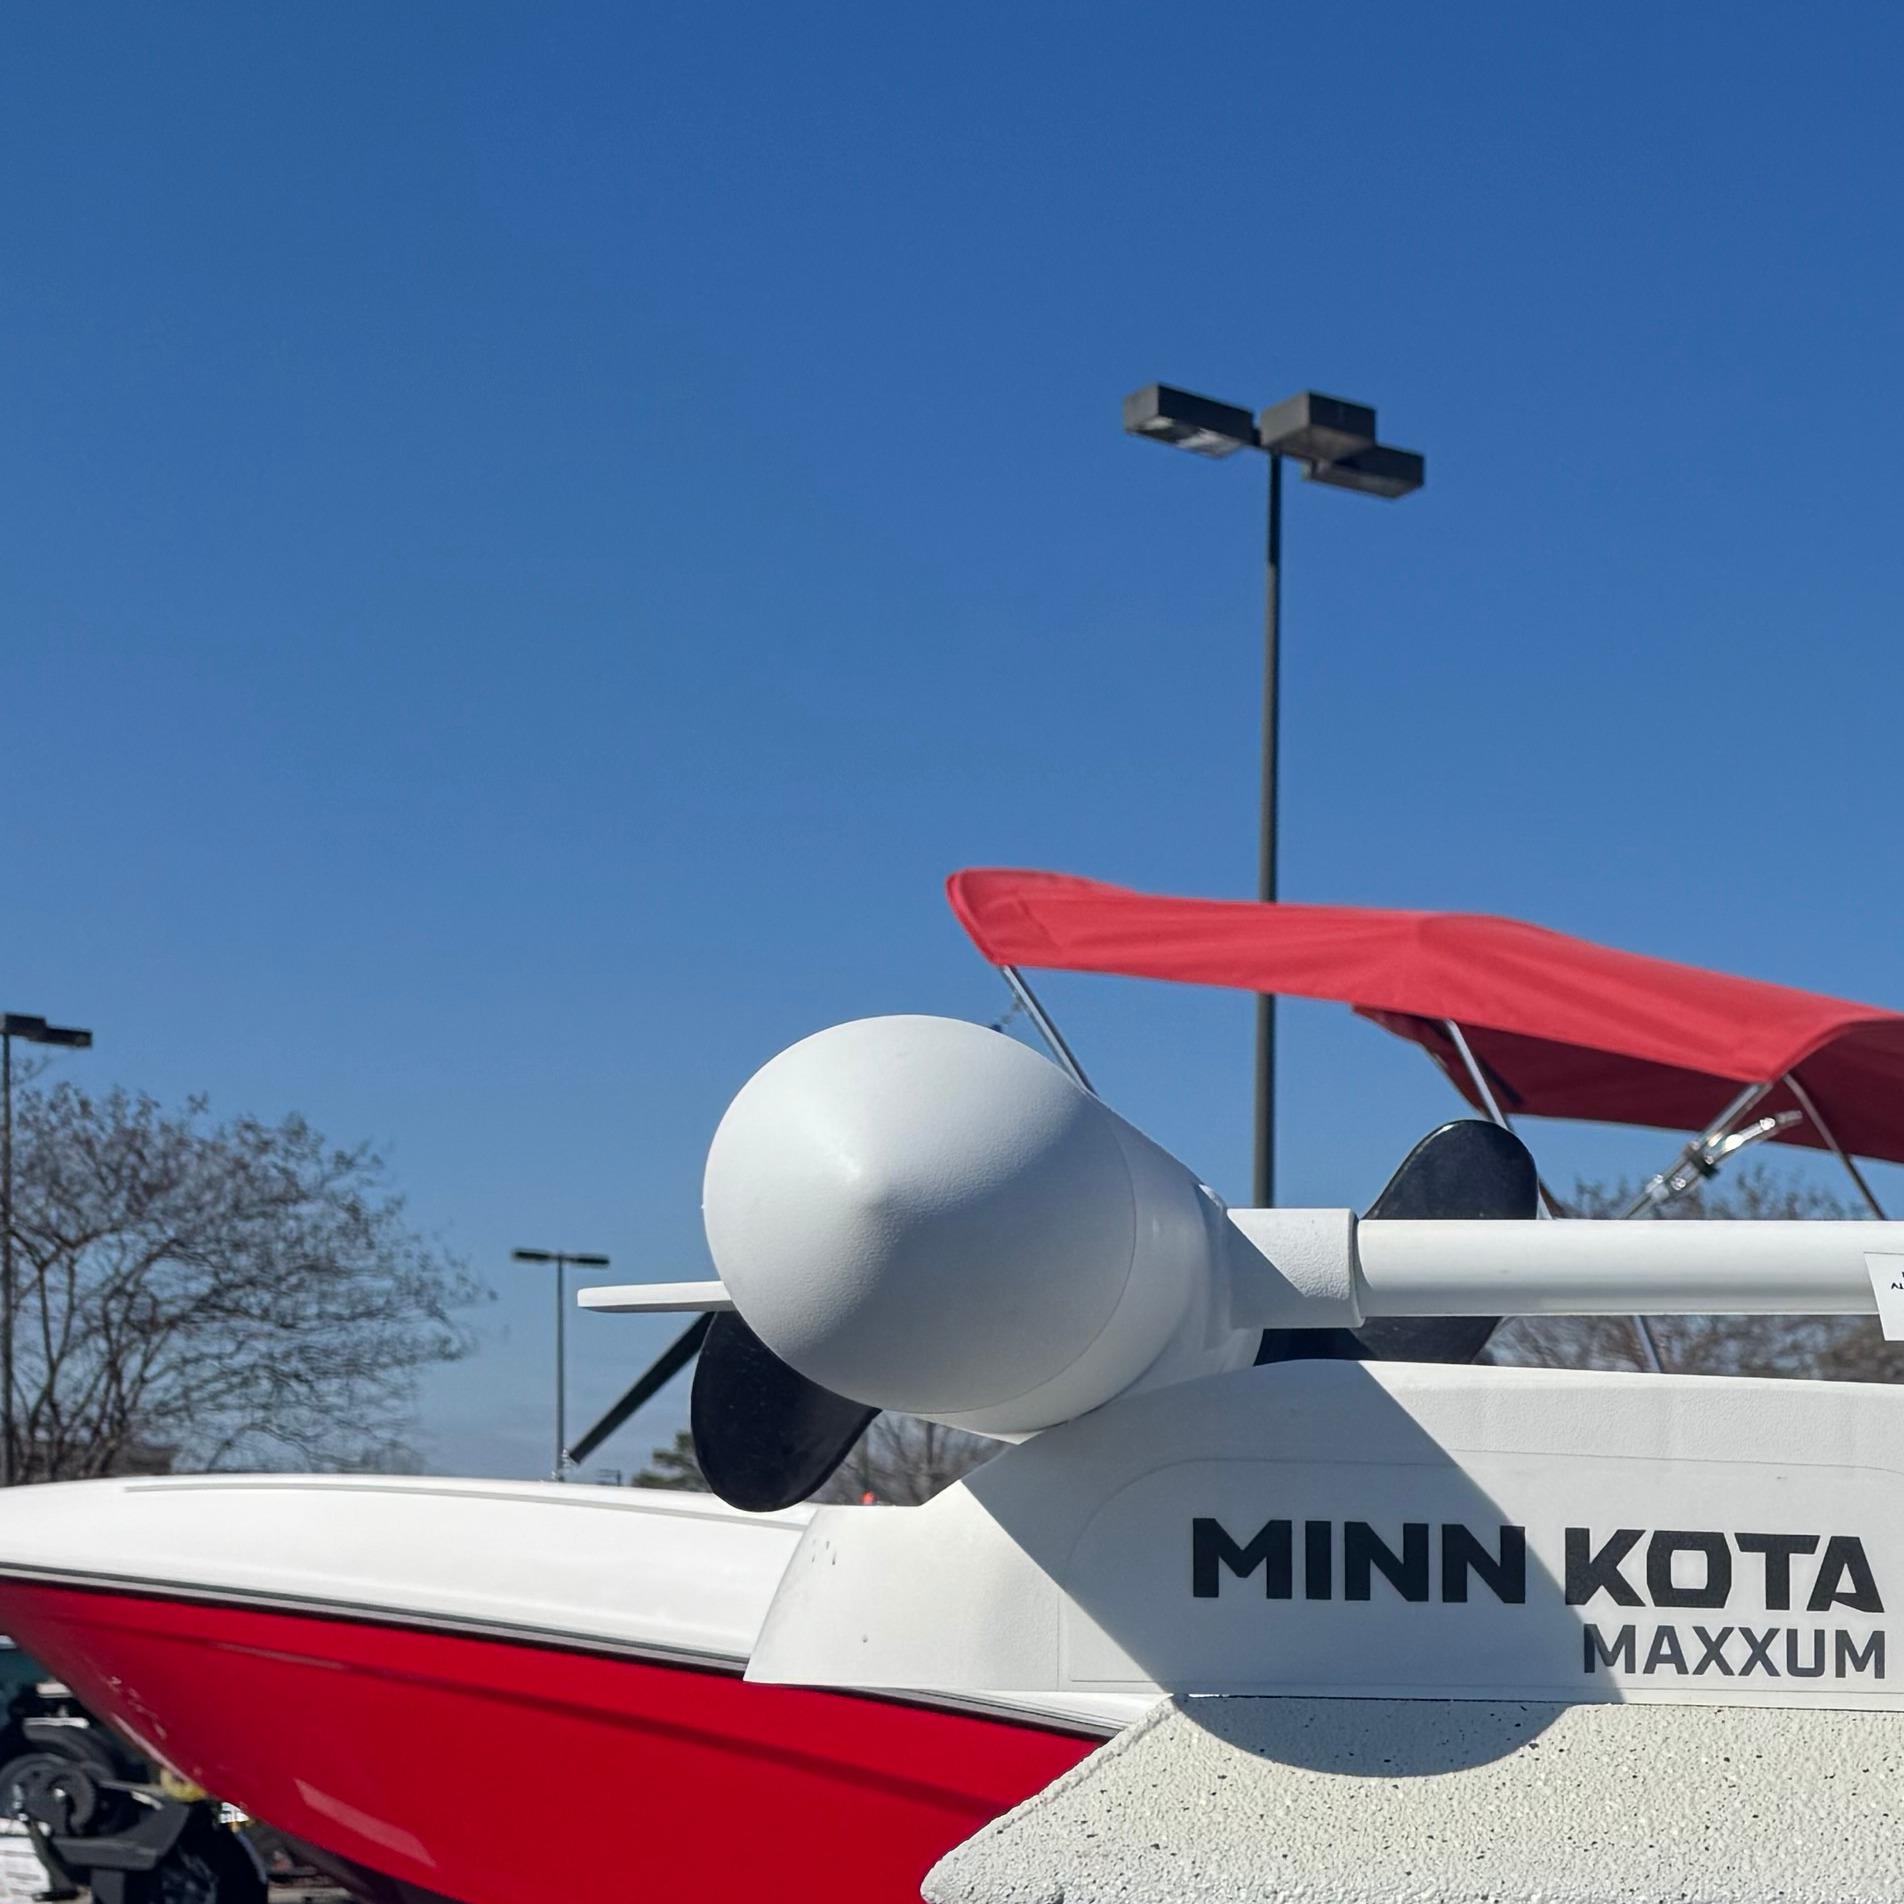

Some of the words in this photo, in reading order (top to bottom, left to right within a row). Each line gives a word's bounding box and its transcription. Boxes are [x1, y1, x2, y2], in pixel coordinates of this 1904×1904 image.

[1193, 1518, 1526, 1605] MINN
[1564, 1527, 1885, 1613] KOTA
[1584, 1624, 1885, 1680] MAXXUM
